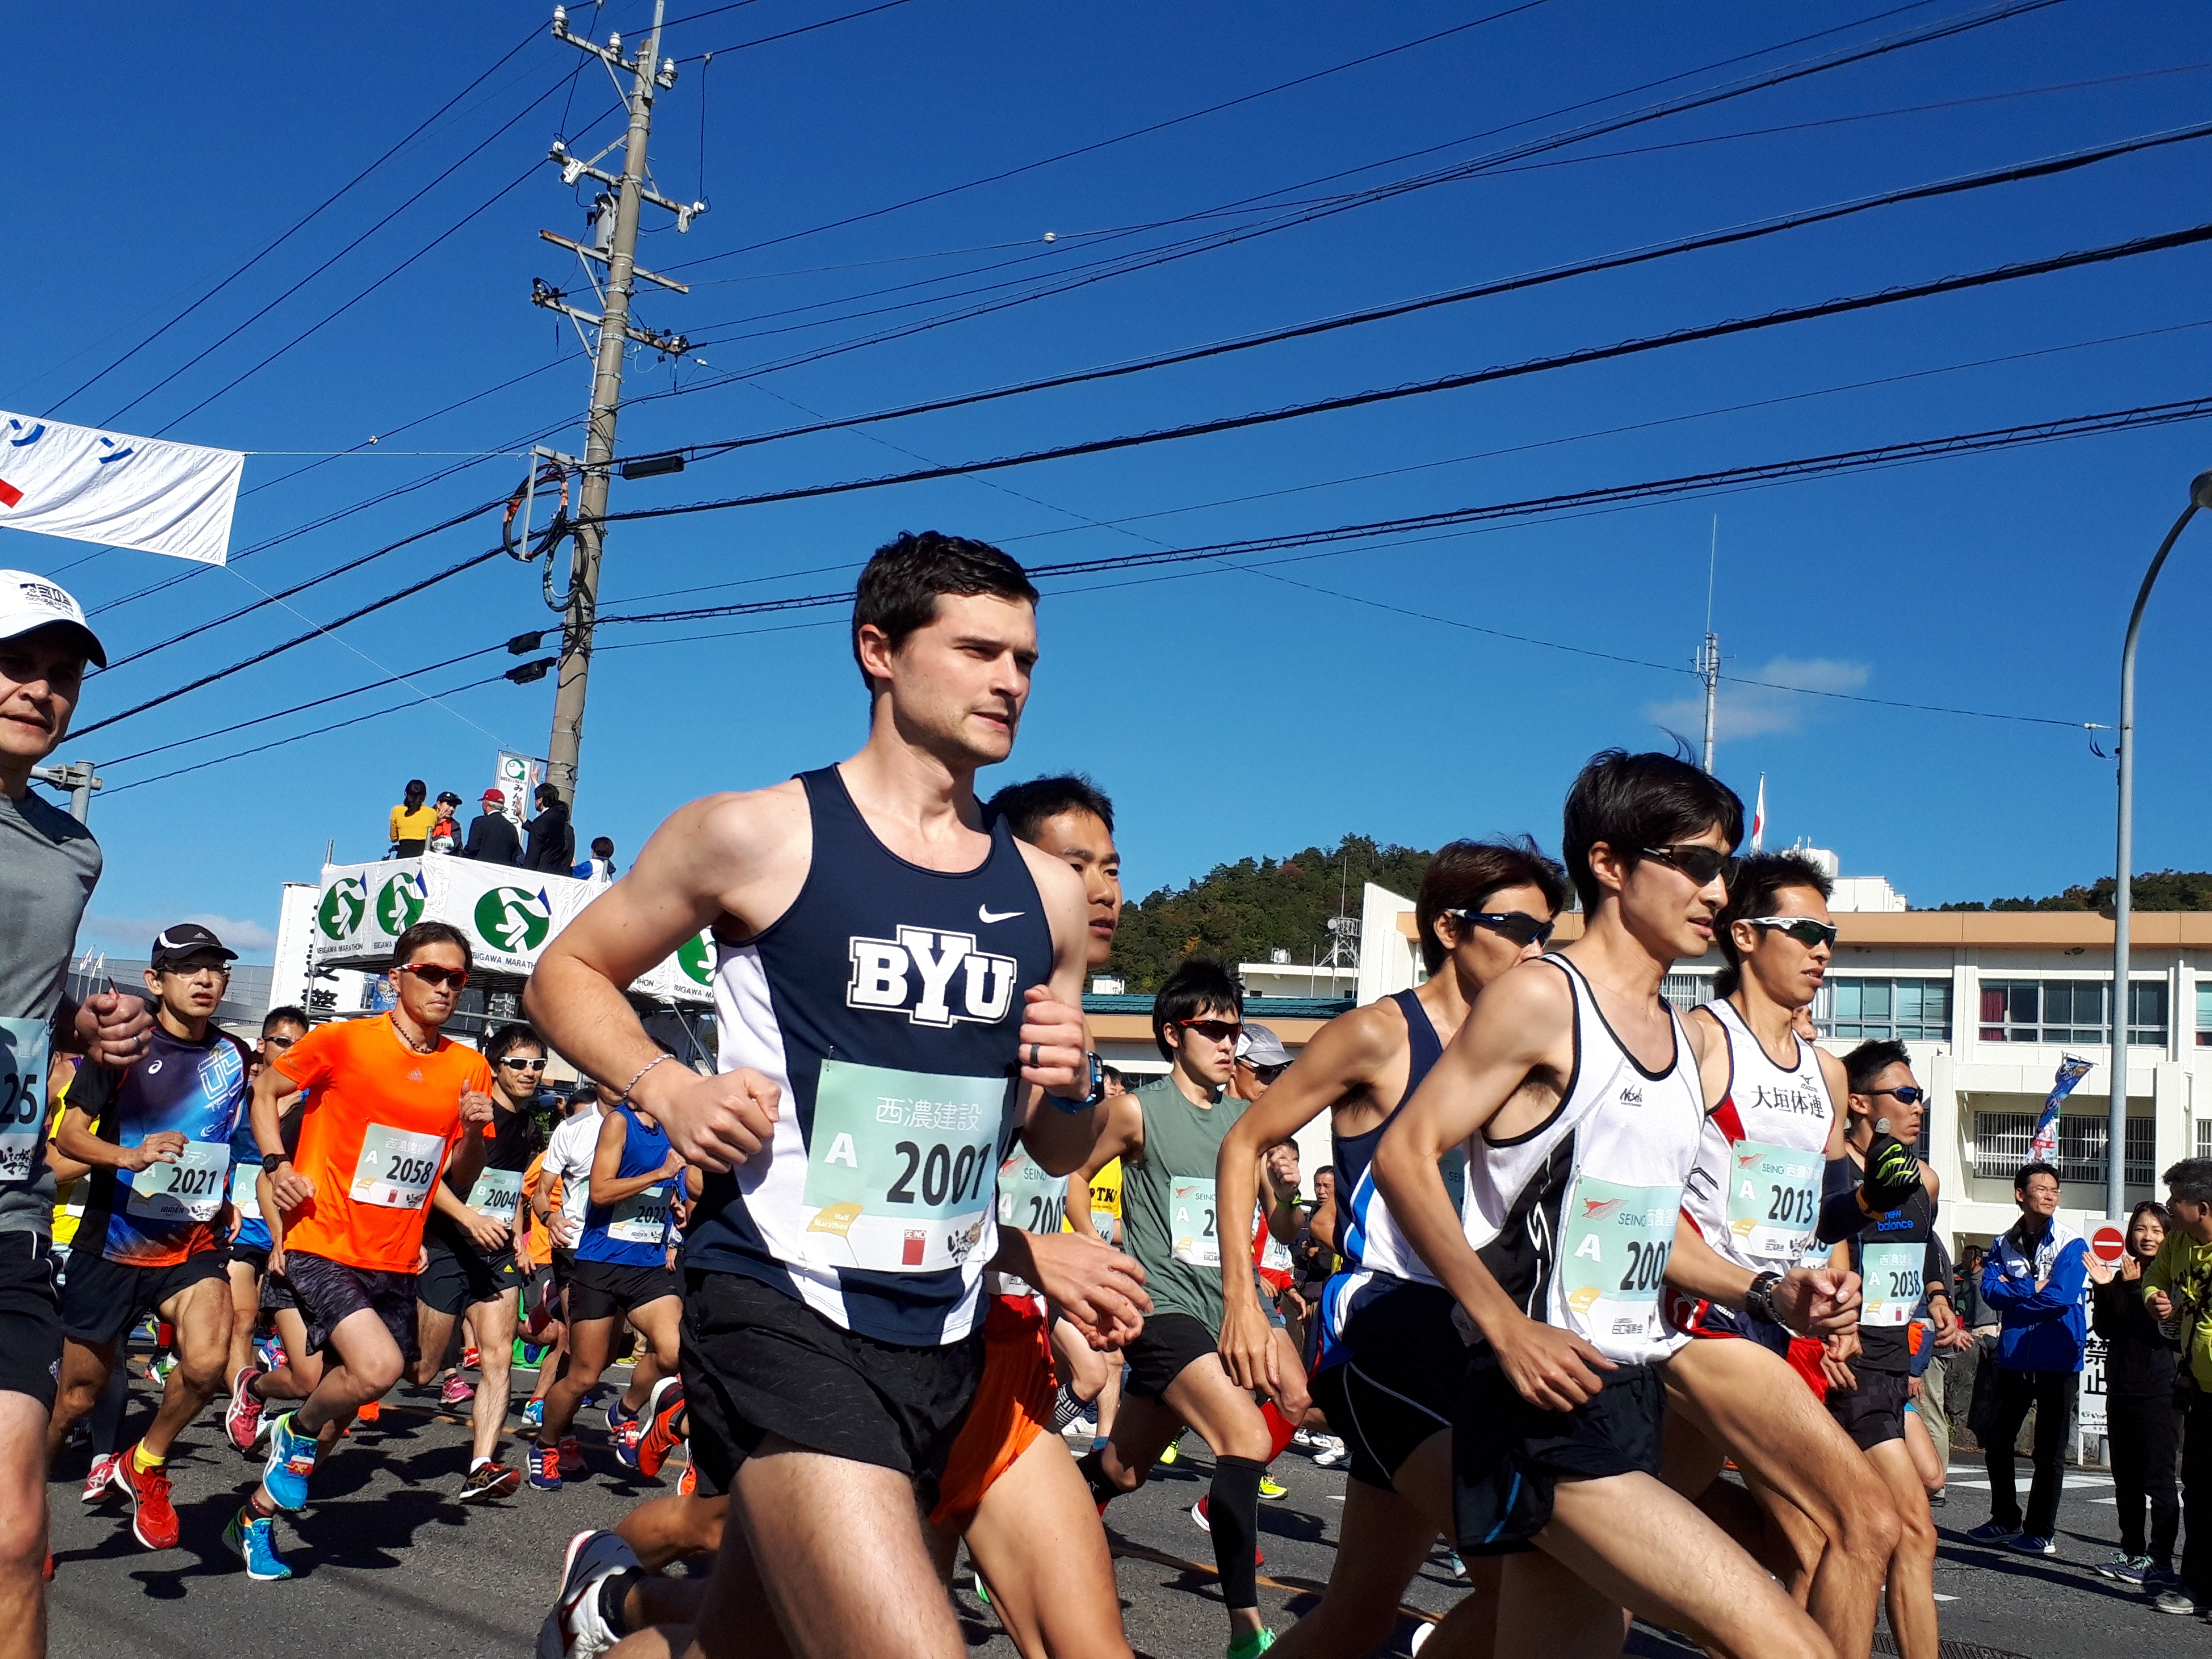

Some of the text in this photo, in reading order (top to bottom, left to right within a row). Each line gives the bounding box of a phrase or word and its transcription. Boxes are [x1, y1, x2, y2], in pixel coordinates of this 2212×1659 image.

[472, 951, 535, 970] BIGAWA MARATH
[847, 925, 1017, 1028] BYU
[0, 1073, 37, 1124] 25
[1751, 1085, 1825, 1119] 大垣体連
[875, 1097, 982, 1131] 西濃建設
[176, 1150, 212, 1166] ビデン
[364, 1150, 434, 1185] A 2058
[824, 1132, 992, 1206] A 2001
[1762, 1163, 1784, 1175] SEINO
[142, 1165, 217, 1195] A 2021
[237, 1181, 247, 1191] A
[477, 1185, 487, 1195] B
[635, 1205, 666, 1224] 2022
[999, 1193, 1012, 1219] A
[1176, 1206, 1190, 1223] A
[1738, 1179, 1813, 1224] A 2013
[1884, 1210, 1901, 1219] new
[1618, 1213, 1646, 1226] SEINO
[1877, 1219, 1914, 1231] balance
[1574, 1233, 1672, 1291] A 200
[1868, 1270, 1921, 1298] A 2038
